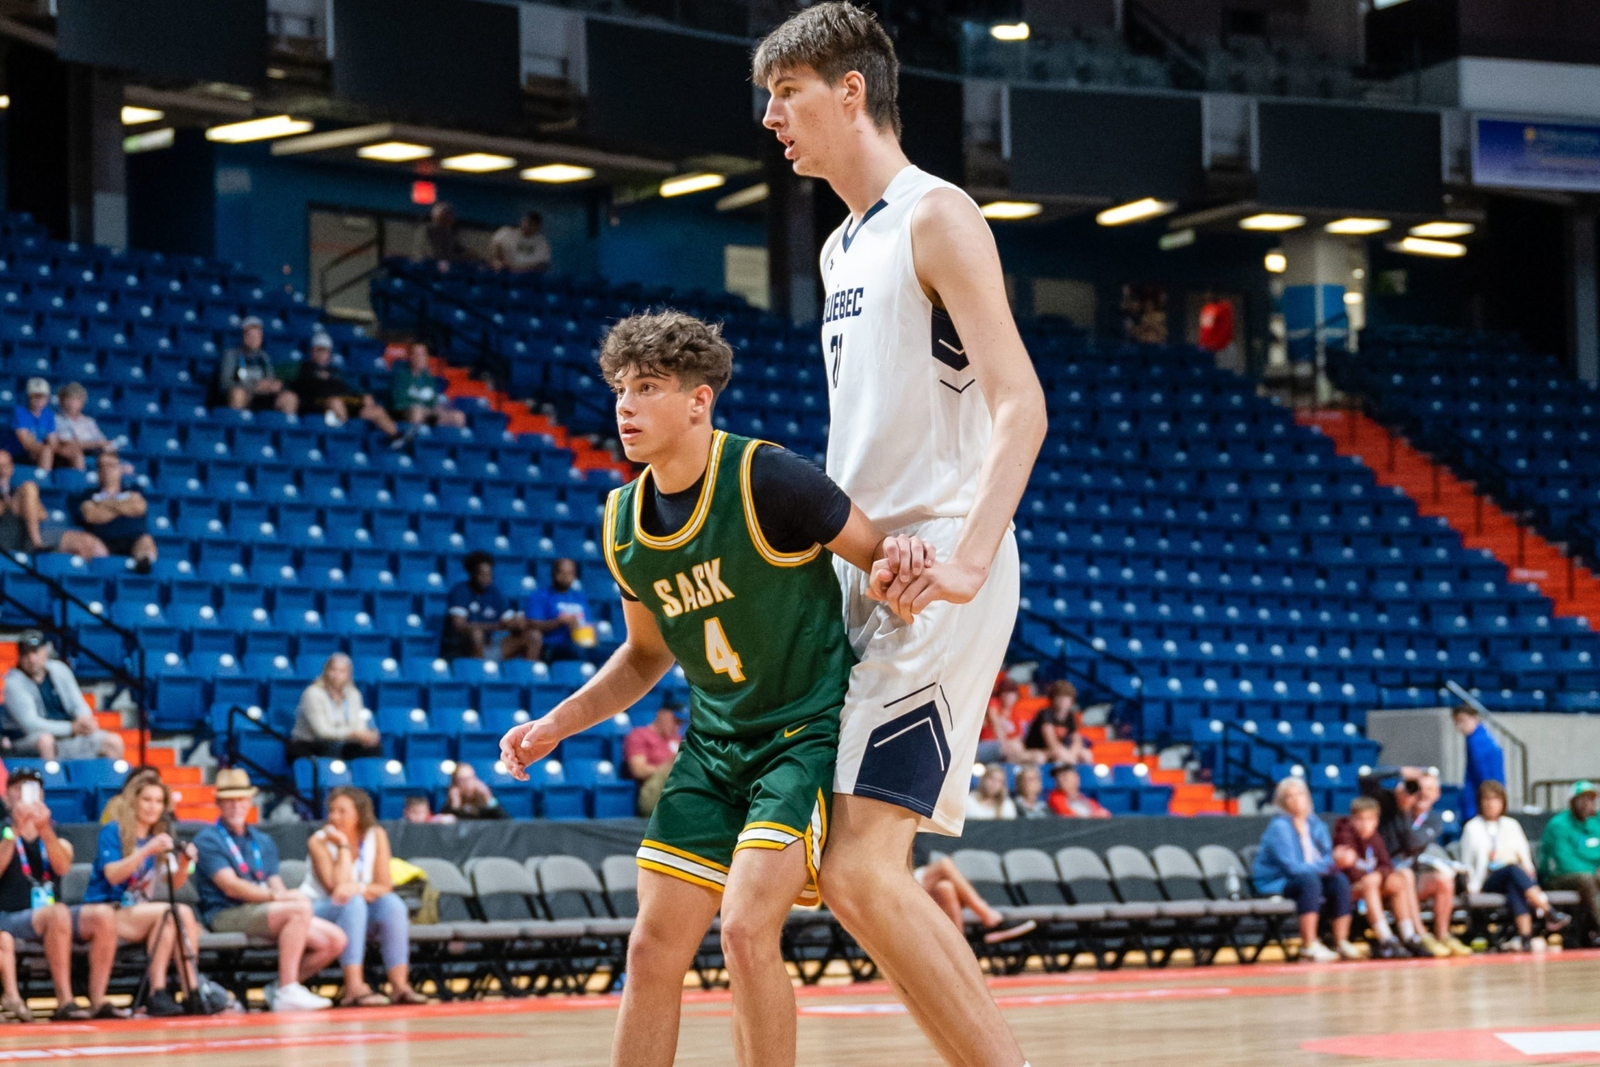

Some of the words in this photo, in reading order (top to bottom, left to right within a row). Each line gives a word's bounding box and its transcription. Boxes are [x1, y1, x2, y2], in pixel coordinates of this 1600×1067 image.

[822, 284, 864, 326] UÉBEC
[653, 557, 736, 618] SASK
[704, 616, 747, 683] 4
